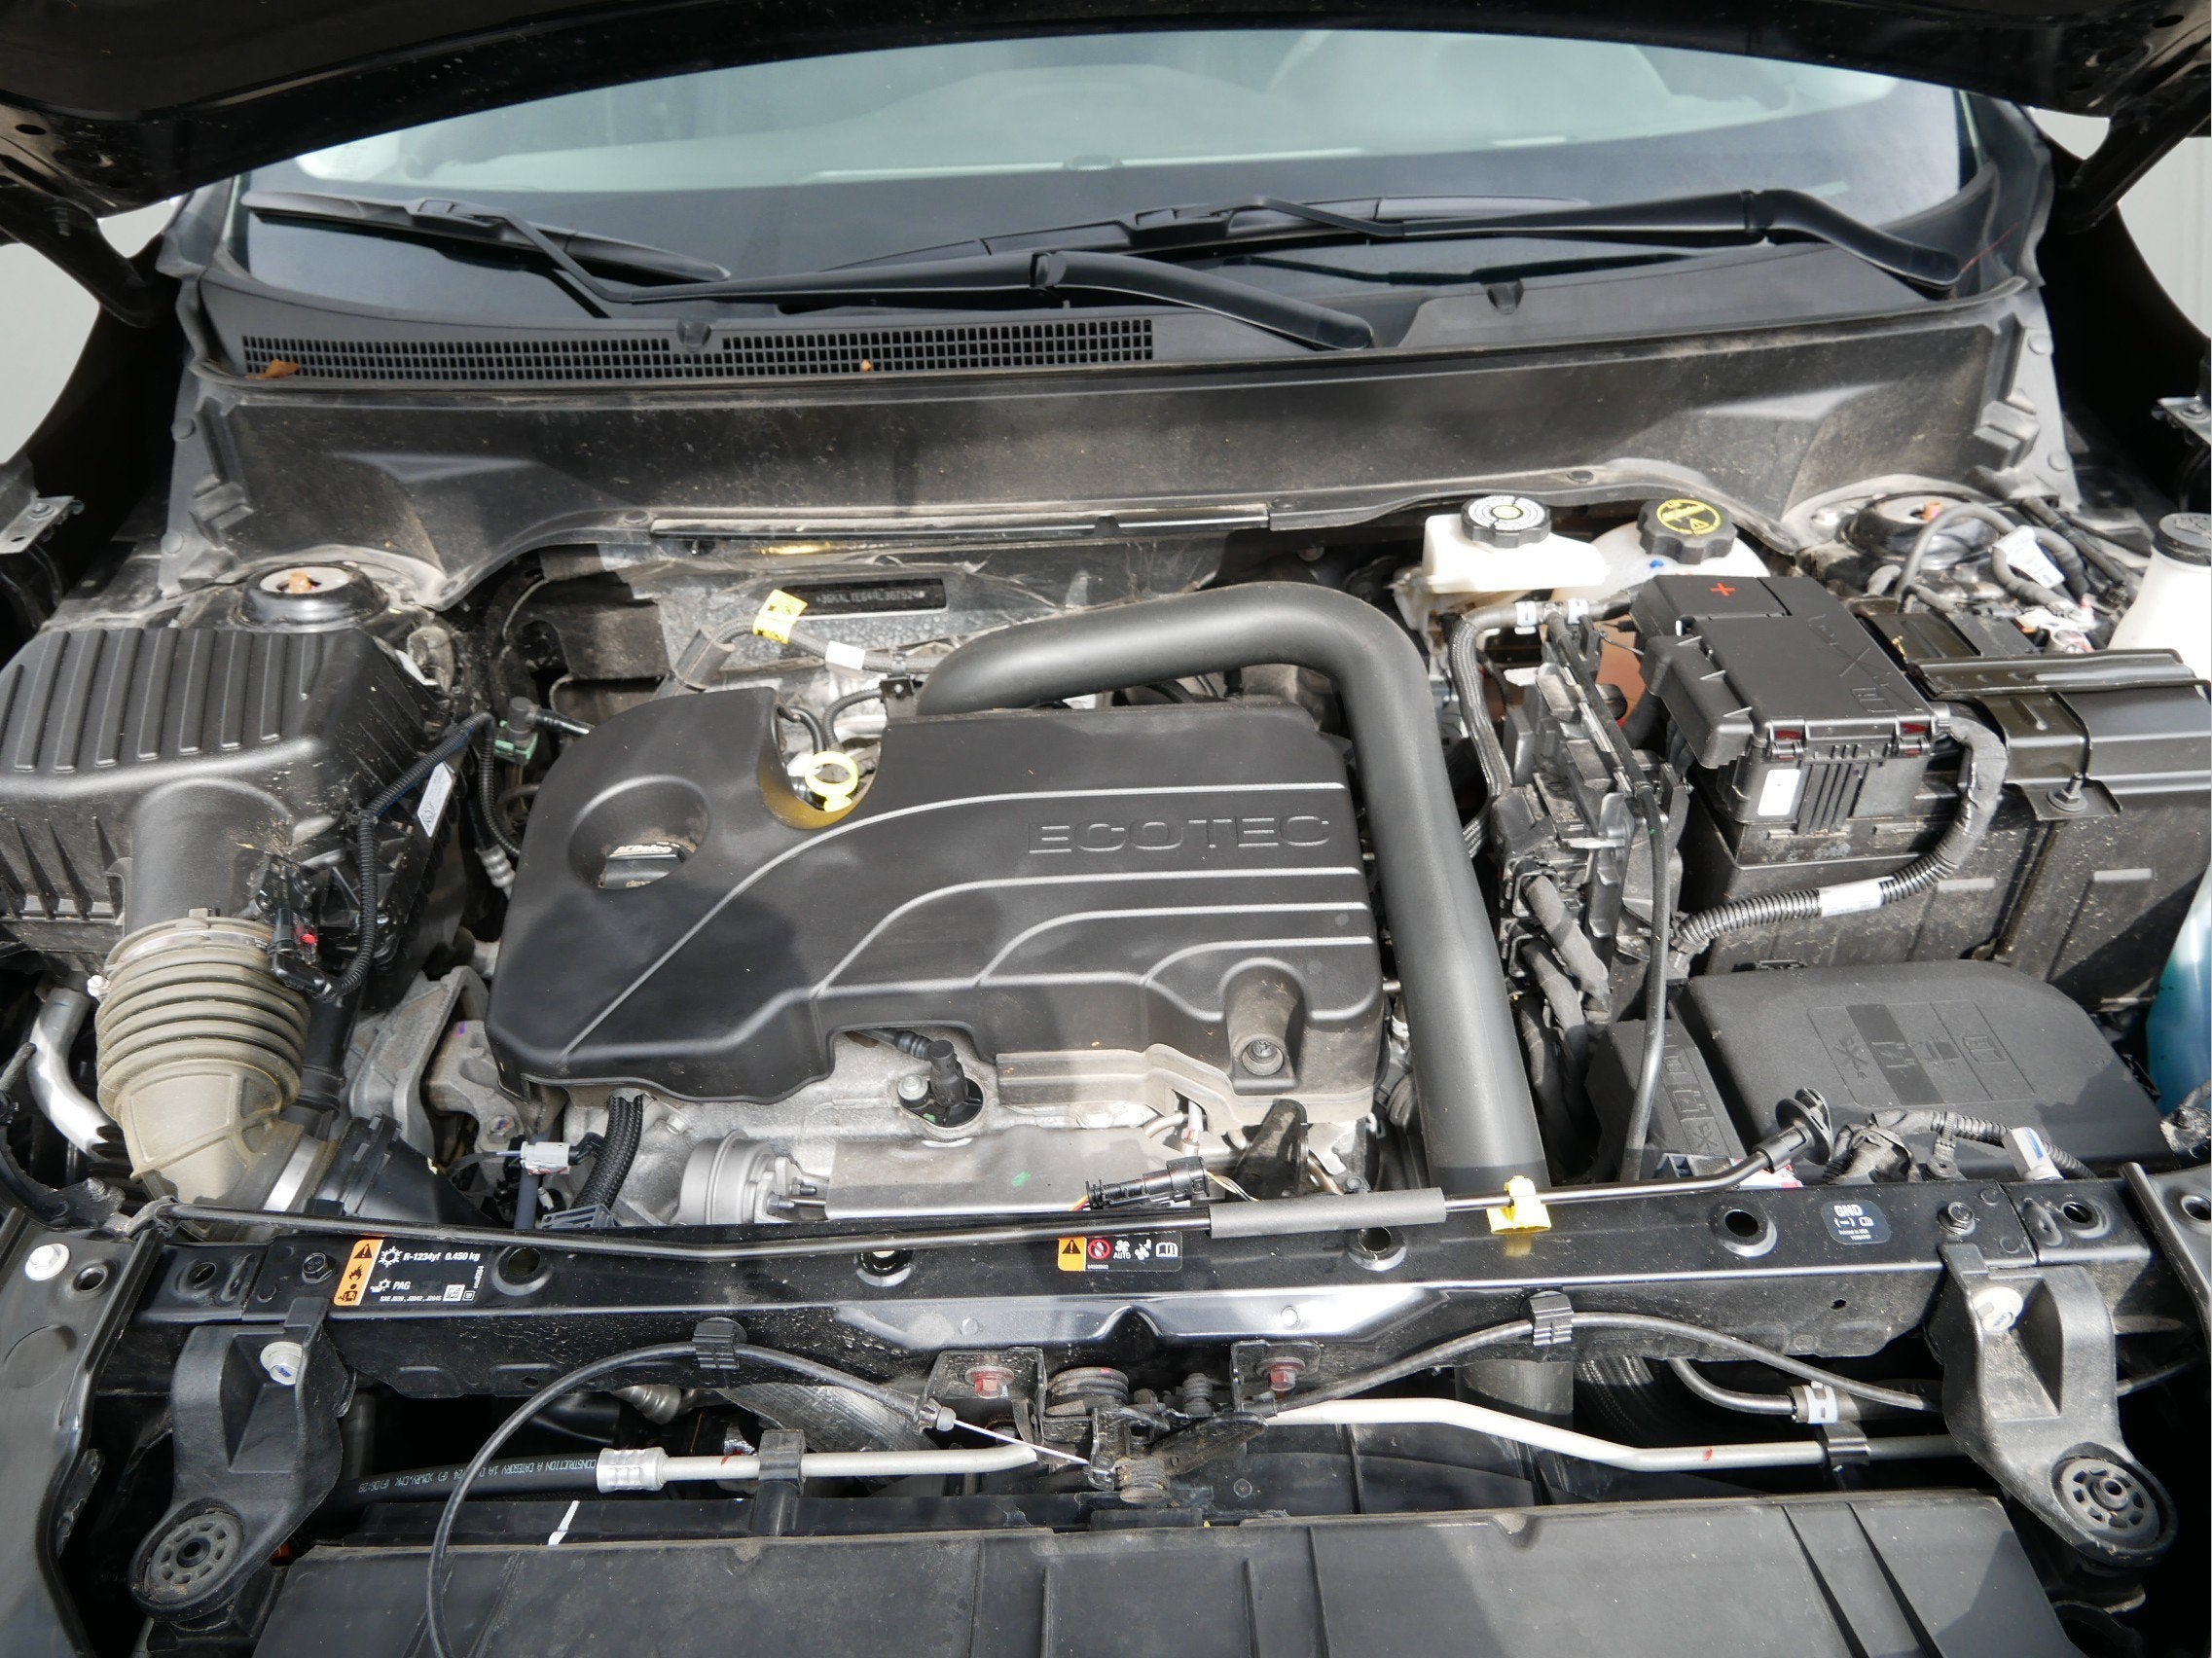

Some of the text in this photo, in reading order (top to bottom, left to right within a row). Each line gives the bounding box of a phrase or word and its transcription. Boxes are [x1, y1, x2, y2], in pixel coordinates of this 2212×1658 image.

[1028, 815, 1331, 854] ECOTEC
[1834, 1205, 1863, 1216] GND
[403, 1252, 481, 1262] R-1234yf 0.450 kg
[393, 1281, 411, 1290] PAG
[501, 1462, 534, 1475] CATEGORY
[545, 1459, 597, 1472] CONSTRUCTION
